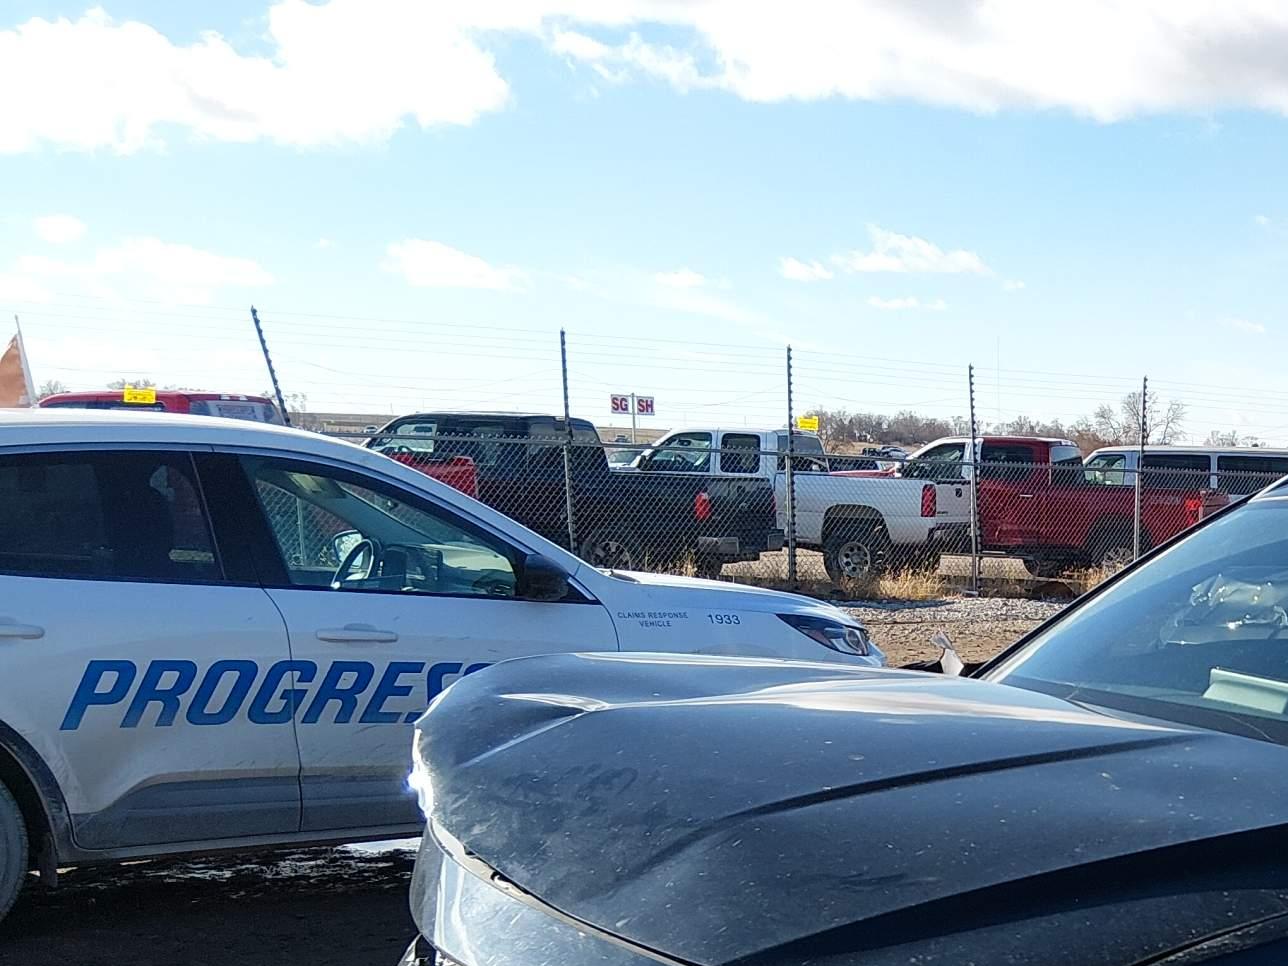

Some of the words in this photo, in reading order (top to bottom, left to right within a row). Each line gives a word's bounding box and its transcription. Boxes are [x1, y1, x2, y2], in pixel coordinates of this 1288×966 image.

[611, 397, 629, 411] SG
[637, 399, 654, 413] SH
[639, 620, 672, 628] VEHICLE
[707, 614, 741, 625] 1933
[59, 659, 497, 731] PROGRES
